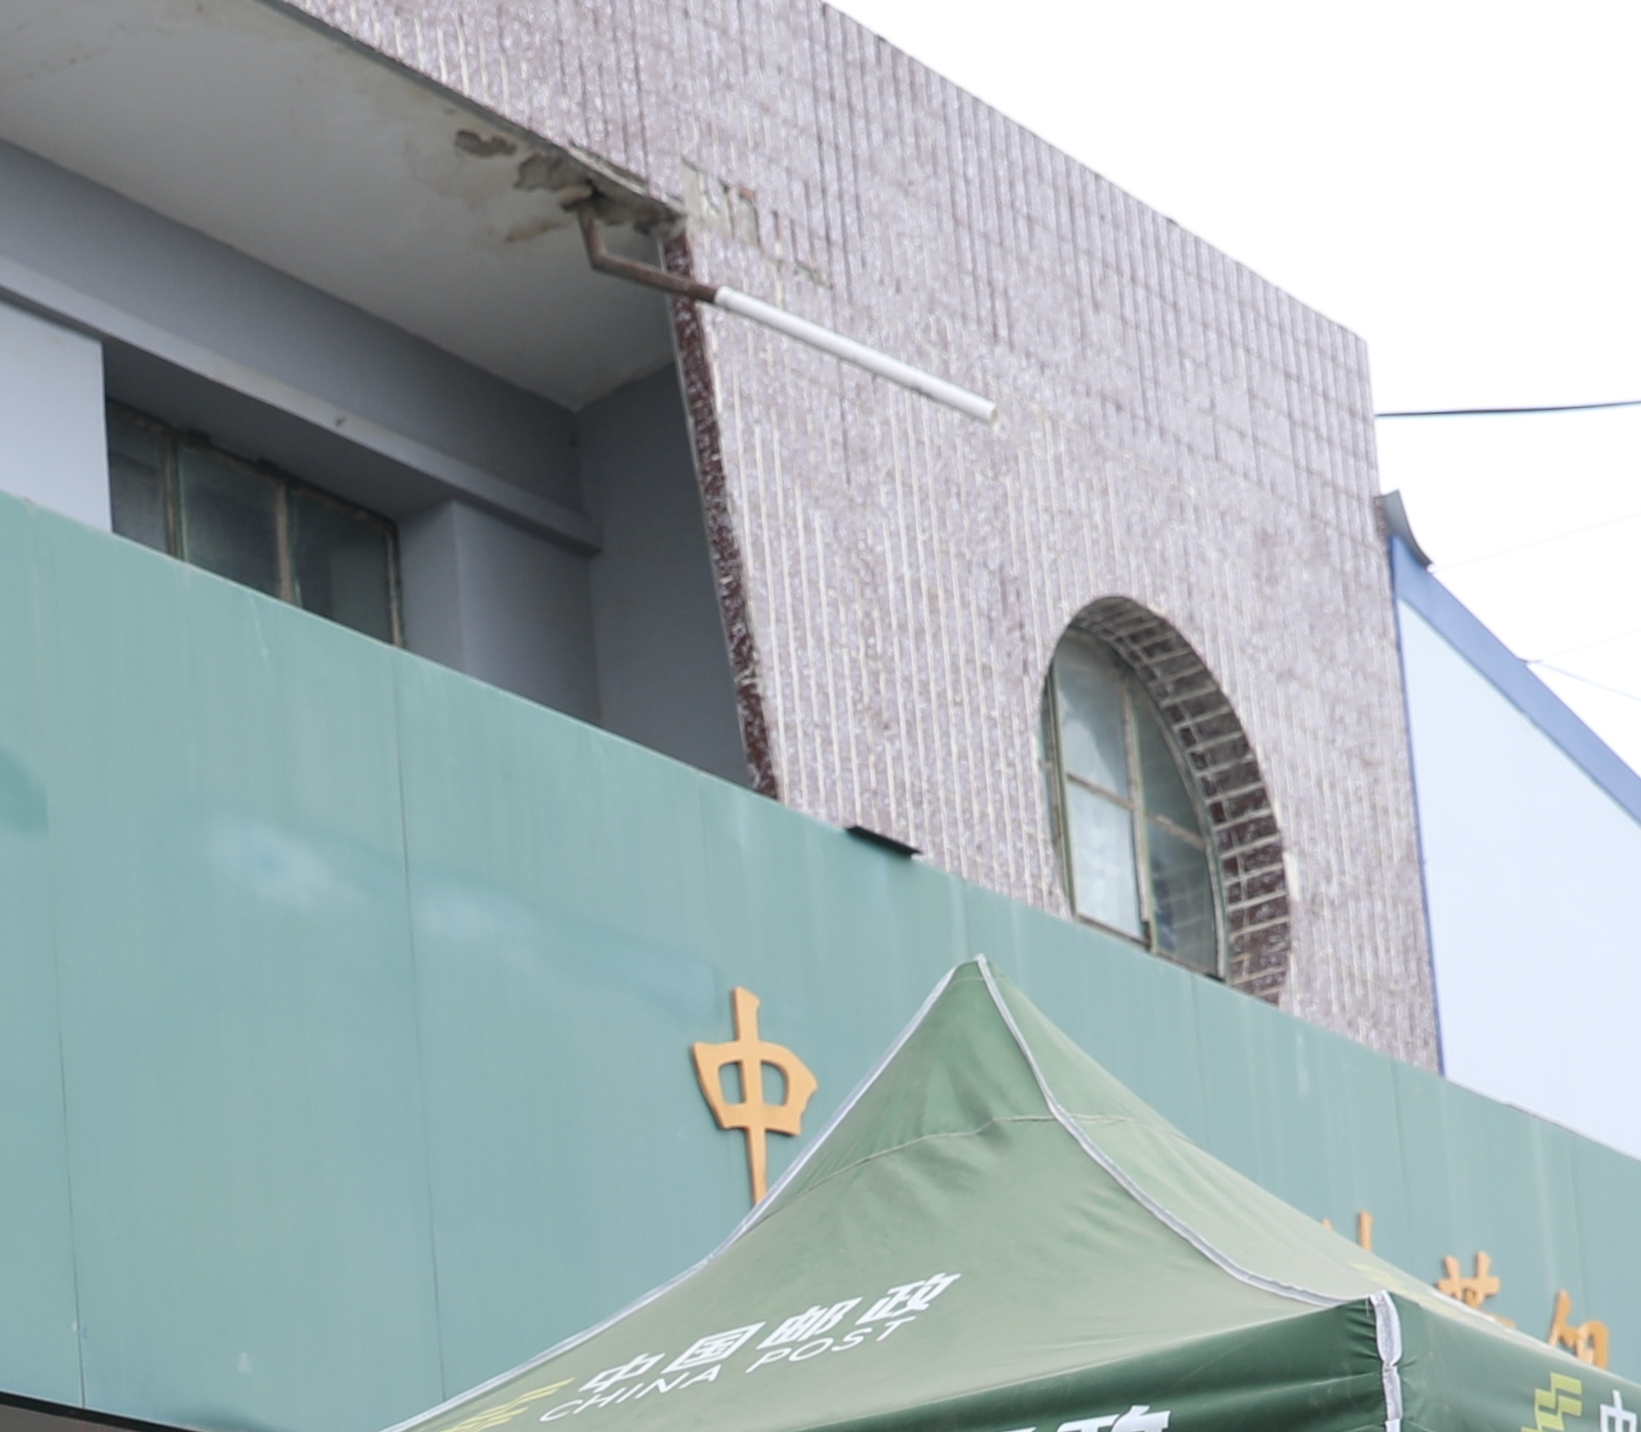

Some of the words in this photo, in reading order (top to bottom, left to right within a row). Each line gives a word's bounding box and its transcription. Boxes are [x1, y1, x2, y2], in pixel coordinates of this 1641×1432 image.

[537, 1365, 721, 1425] CHINA
[761, 1316, 920, 1367] POST
[578, 1271, 962, 1397] 中国邮政
